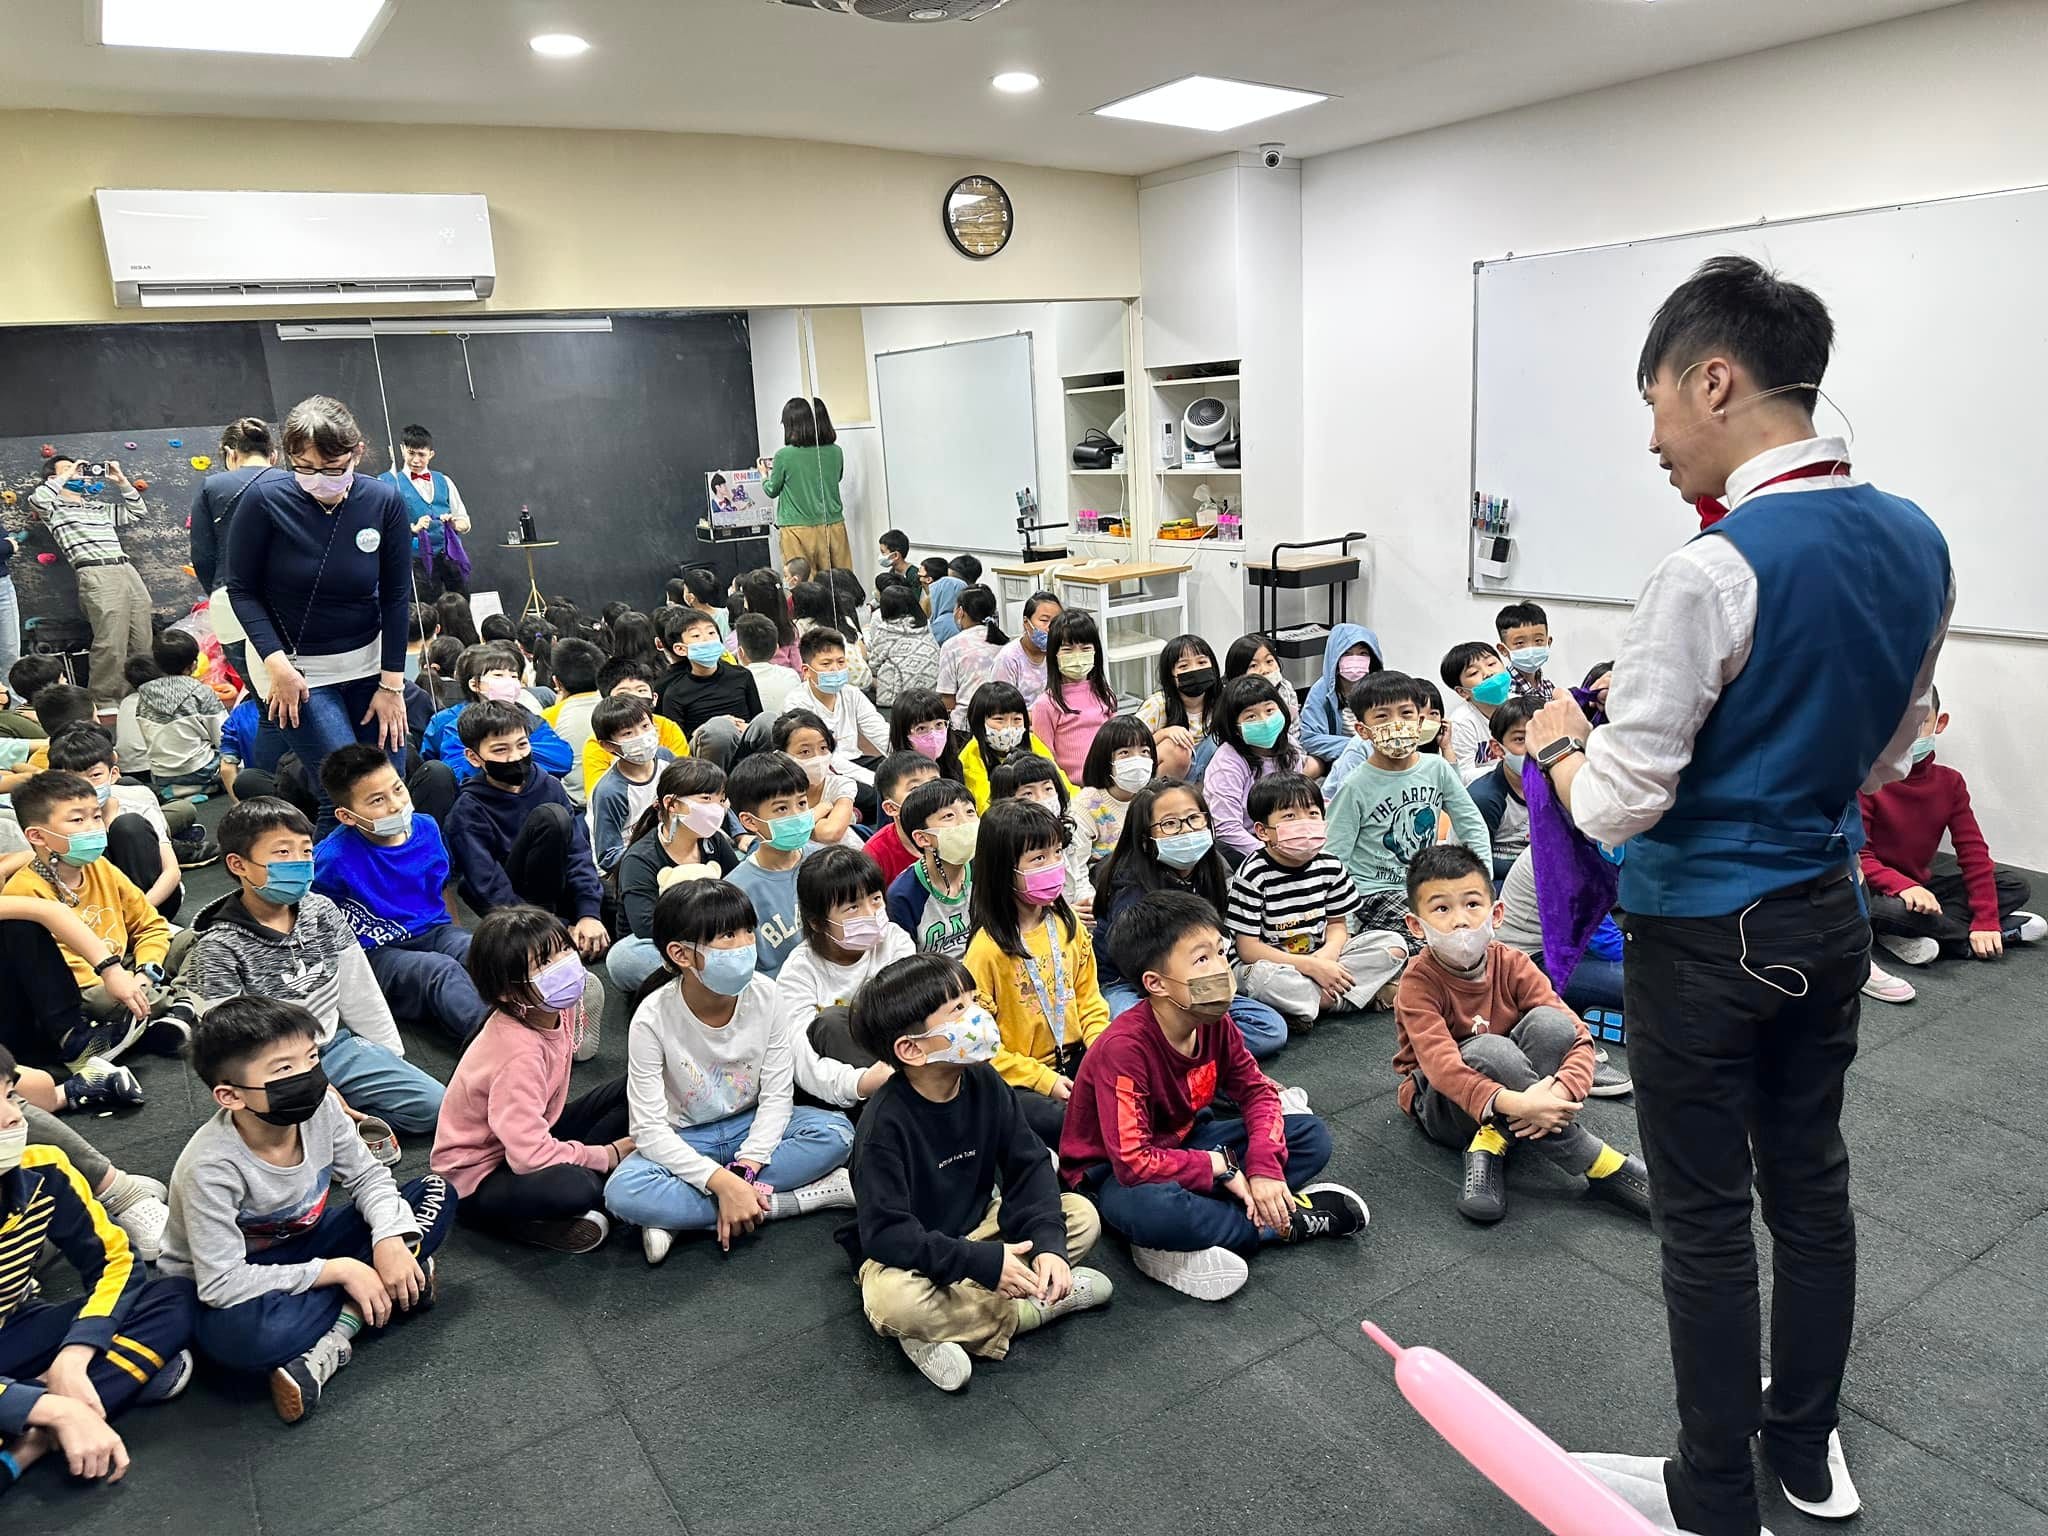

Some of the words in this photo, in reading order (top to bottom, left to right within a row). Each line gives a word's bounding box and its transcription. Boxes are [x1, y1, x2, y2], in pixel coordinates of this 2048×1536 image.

[972, 179, 983, 188] 12
[950, 212, 957, 223] 9
[1001, 211, 1008, 221] 3
[978, 242, 985, 253] 6
[1369, 796, 1397, 824] THE
[1401, 786, 1444, 807] ARCTIC
[414, 1174, 447, 1233] ATMAN
